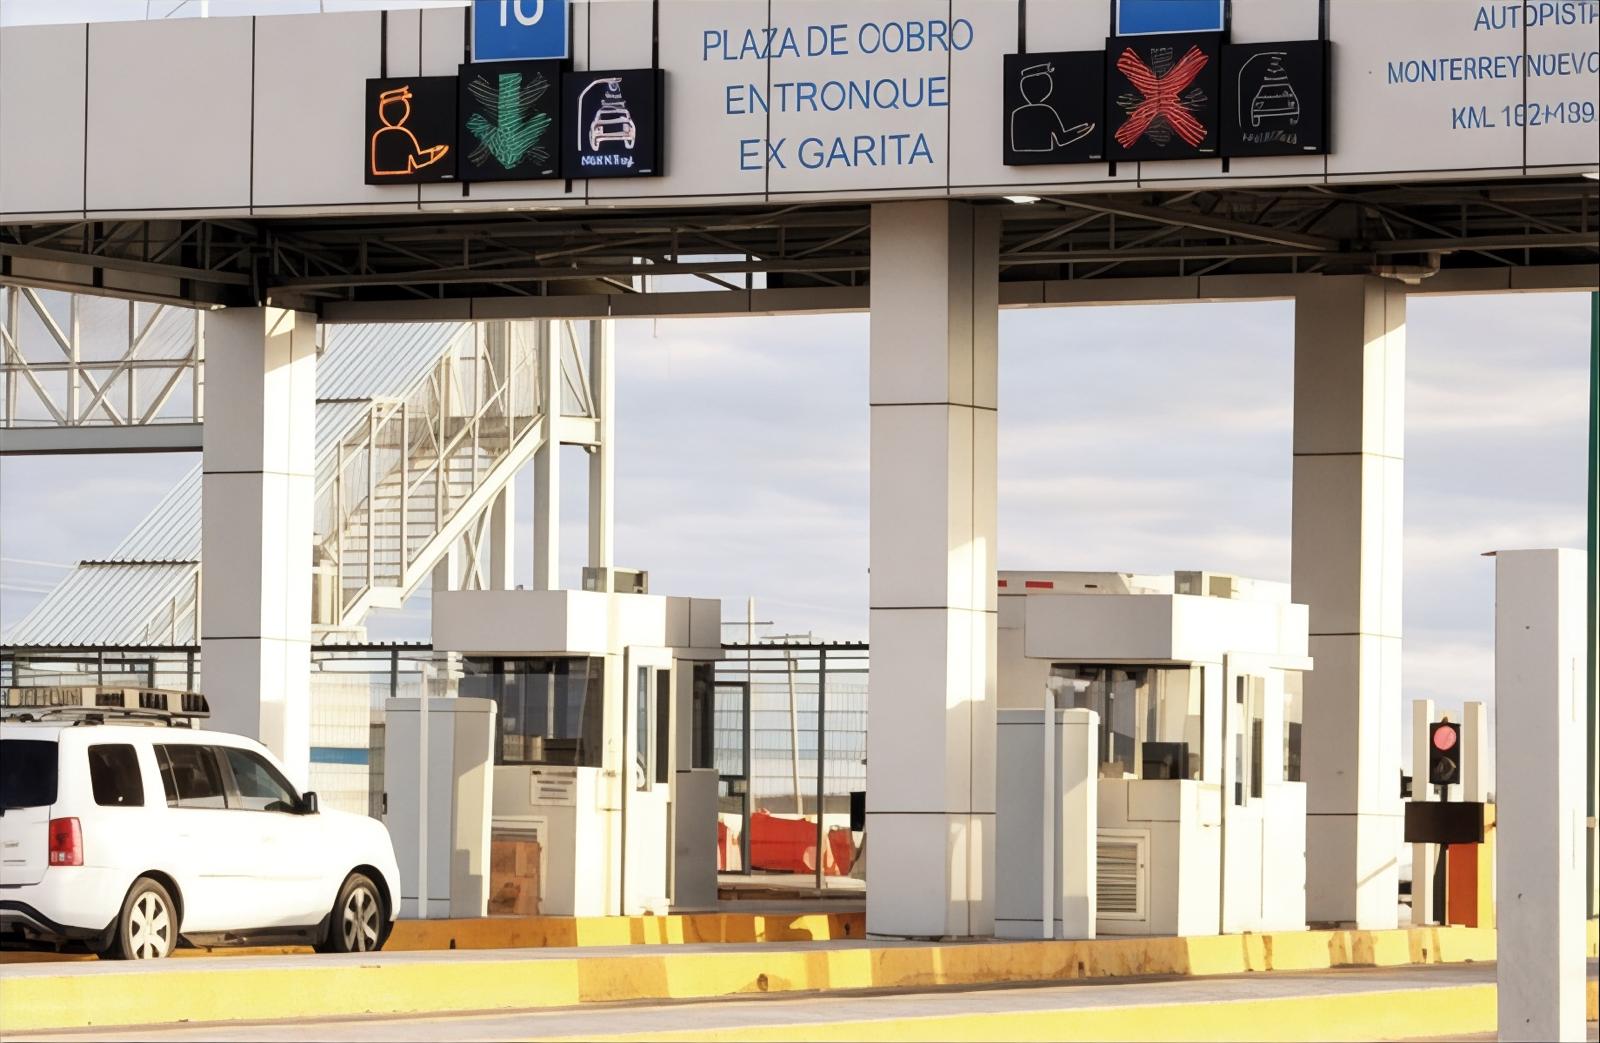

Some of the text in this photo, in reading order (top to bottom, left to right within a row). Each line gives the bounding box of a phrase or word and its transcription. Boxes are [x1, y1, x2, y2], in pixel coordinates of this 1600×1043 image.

[703, 27, 801, 61] PLAZA
[807, 24, 849, 57] DE
[1387, 55, 1523, 84] MONTERREY
[726, 76, 949, 115] ENTRONQUE
[740, 132, 934, 170] EX GARITA
